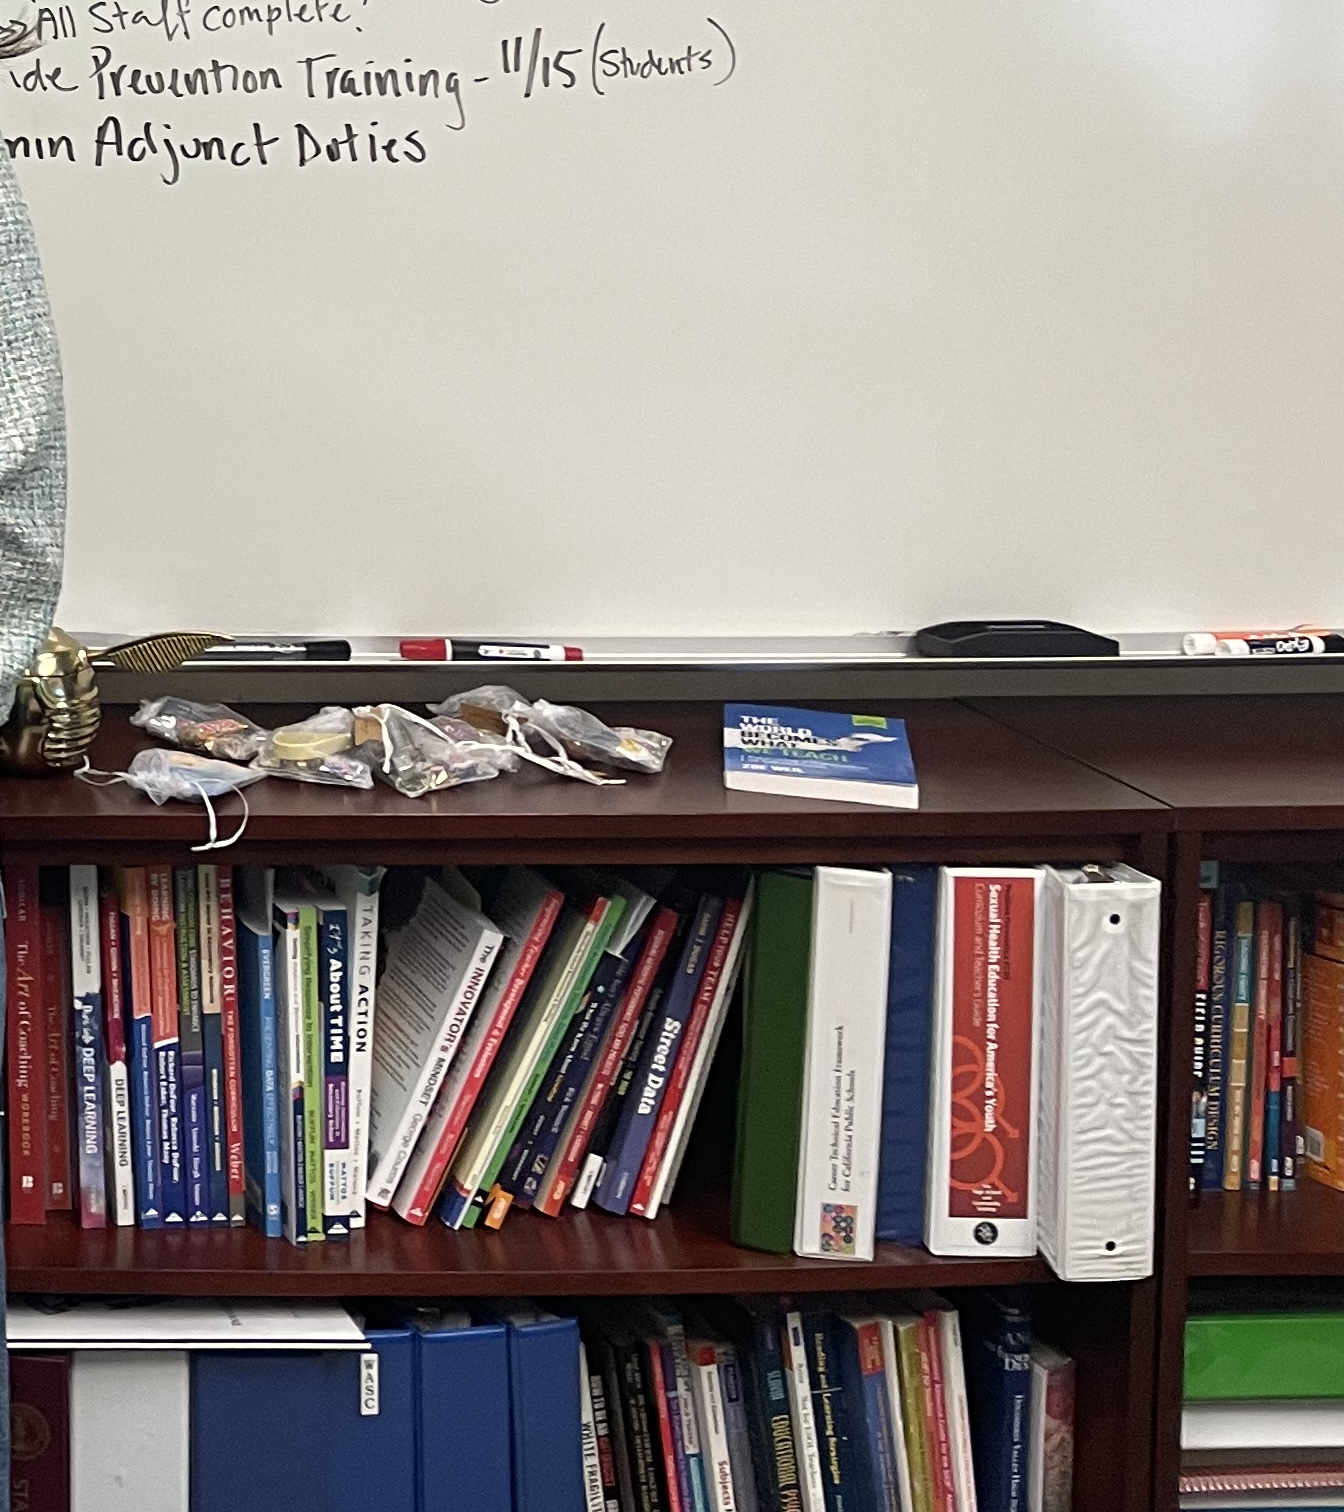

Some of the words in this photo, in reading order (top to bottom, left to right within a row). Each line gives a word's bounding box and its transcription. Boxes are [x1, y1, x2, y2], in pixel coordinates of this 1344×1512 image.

[35, 5, 77, 40] All
[88, 44, 284, 102] Prevention
[295, 52, 466, 130] Training
[593, 16, 738, 96] (Students)
[93, 119, 281, 186] Adjunct
[739, 723, 812, 737] WORLD
[740, 715, 779, 726] THE
[988, 884, 1002, 922] Sexual
[17, 942, 29, 967] The
[358, 905, 374, 976] TAKING
[478, 943, 494, 964] The
[988, 924, 1002, 962] Health
[17, 968, 34, 997] Art
[261, 949, 271, 1000] EVERGREEN
[329, 959, 345, 1012] About
[1210, 929, 1228, 1001] RIGOROUS
[18, 1002, 32, 1018] of
[438, 965, 484, 1055] INNOVATOR's
[986, 964, 1000, 1022] Education
[329, 1016, 344, 1063] TIME
[355, 984, 369, 1053] ACTION
[984, 1023, 1000, 1039] for
[17, 1020, 33, 1087] Coaching
[82, 1048, 94, 1082] DEEP
[650, 1016, 683, 1074] Street
[832, 1025, 844, 1072] Framework
[1205, 1004, 1225, 1096] CURRICULUM
[844, 1070, 856, 1102] Schools
[985, 1042, 999, 1097] America's
[115, 1079, 126, 1108] DEEP
[636, 1072, 665, 1118] Data
[830, 1075, 842, 1118] Education
[983, 1098, 997, 1132] Youth
[84, 1086, 97, 1154] LEARNING
[116, 1111, 129, 1167] LEARNING
[829, 1120, 840, 1162] Technical
[843, 1105, 854, 1132] Public
[1204, 1100, 1220, 1150] DESIGN
[229, 1142, 242, 1181] Weber
[842, 1133, 853, 1178] California
[364, 1358, 376, 1410] WASC
[822, 1393, 835, 1436] Learning
[581, 1421, 595, 1461] WHITE
[771, 1413, 797, 1485] EDUCATIONAL
[717, 1459, 733, 1506] Subjects
